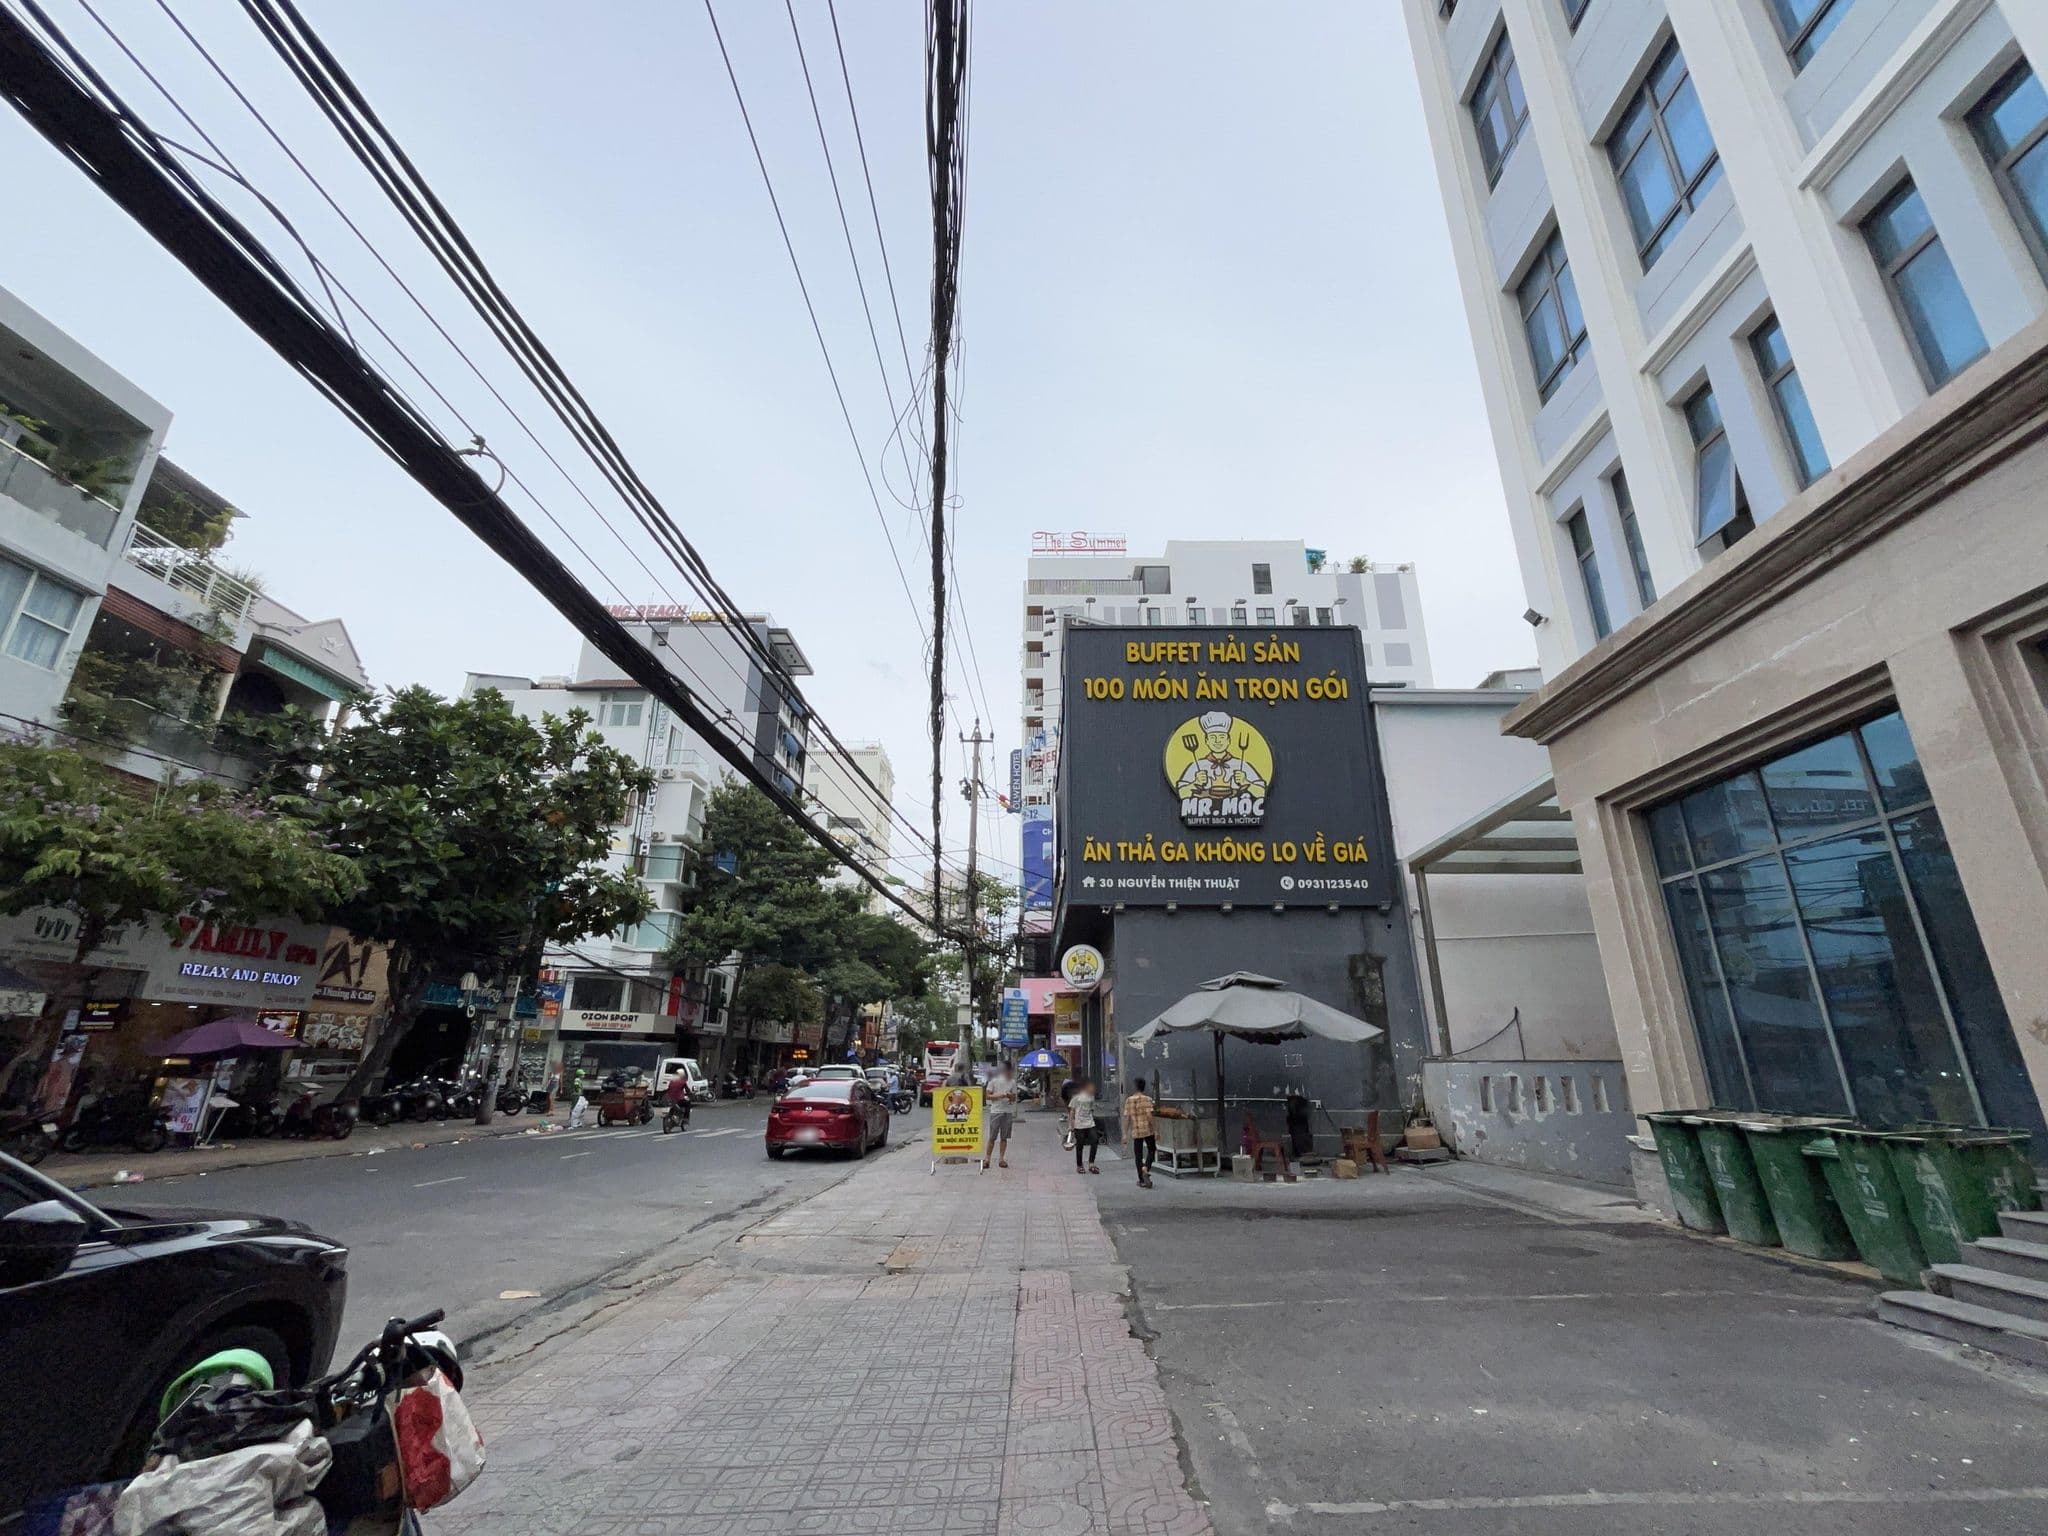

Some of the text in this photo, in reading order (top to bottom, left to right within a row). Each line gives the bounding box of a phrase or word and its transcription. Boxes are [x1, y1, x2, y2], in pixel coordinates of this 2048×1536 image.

[1032, 531, 1127, 556] The Summer
[1126, 634, 1300, 664] BUFFET HẢI SẢN
[1083, 670, 1349, 706] 100 MÓN ĂN TRỌN GÓI
[1013, 751, 1022, 775] HOTEL
[1235, 817, 1260, 825] HOTPOT
[1083, 831, 1369, 864] ĂN THẢ GA KHÔNG LO VỀ GIÁ
[1099, 875, 1241, 891] 30 NGUYỄN THIỆN THUẬT
[1298, 879, 1369, 889] 0931123540
[181, 963, 302, 986] RELAX AND ENJOY
[351, 990, 357, 999] &
[581, 1012, 639, 1022] OZON SPORT
[968, 1126, 979, 1134] XE
